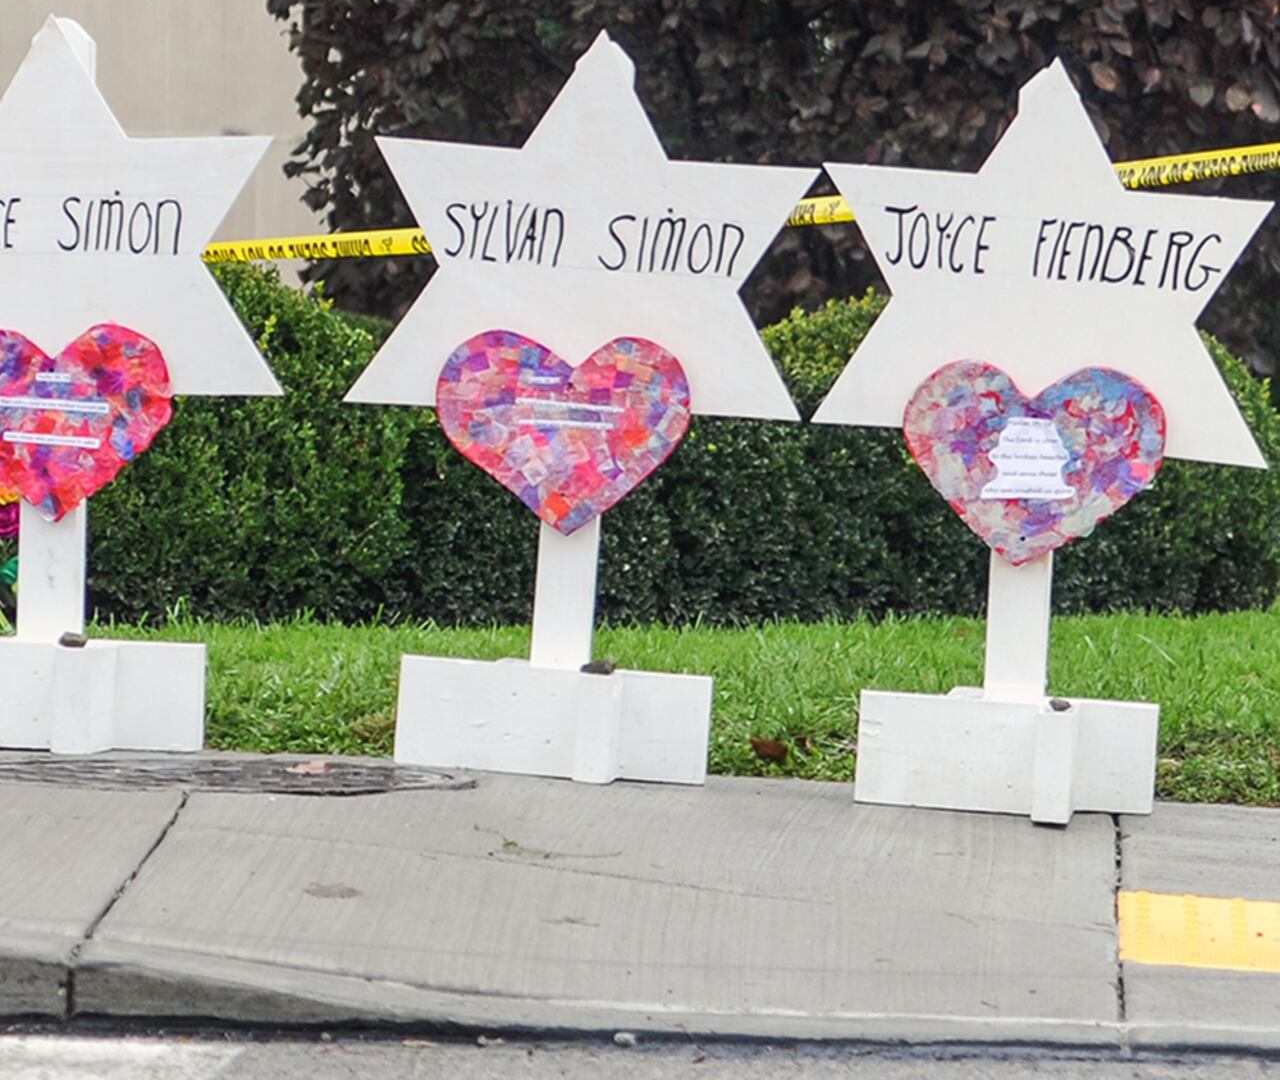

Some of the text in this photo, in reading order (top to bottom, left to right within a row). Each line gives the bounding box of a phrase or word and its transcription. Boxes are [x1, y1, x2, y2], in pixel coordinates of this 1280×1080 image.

[57, 196, 183, 256] SIMON
[444, 199, 745, 277] SYLVAN SIMON
[884, 204, 1222, 292] JOYCE FIENBERG
